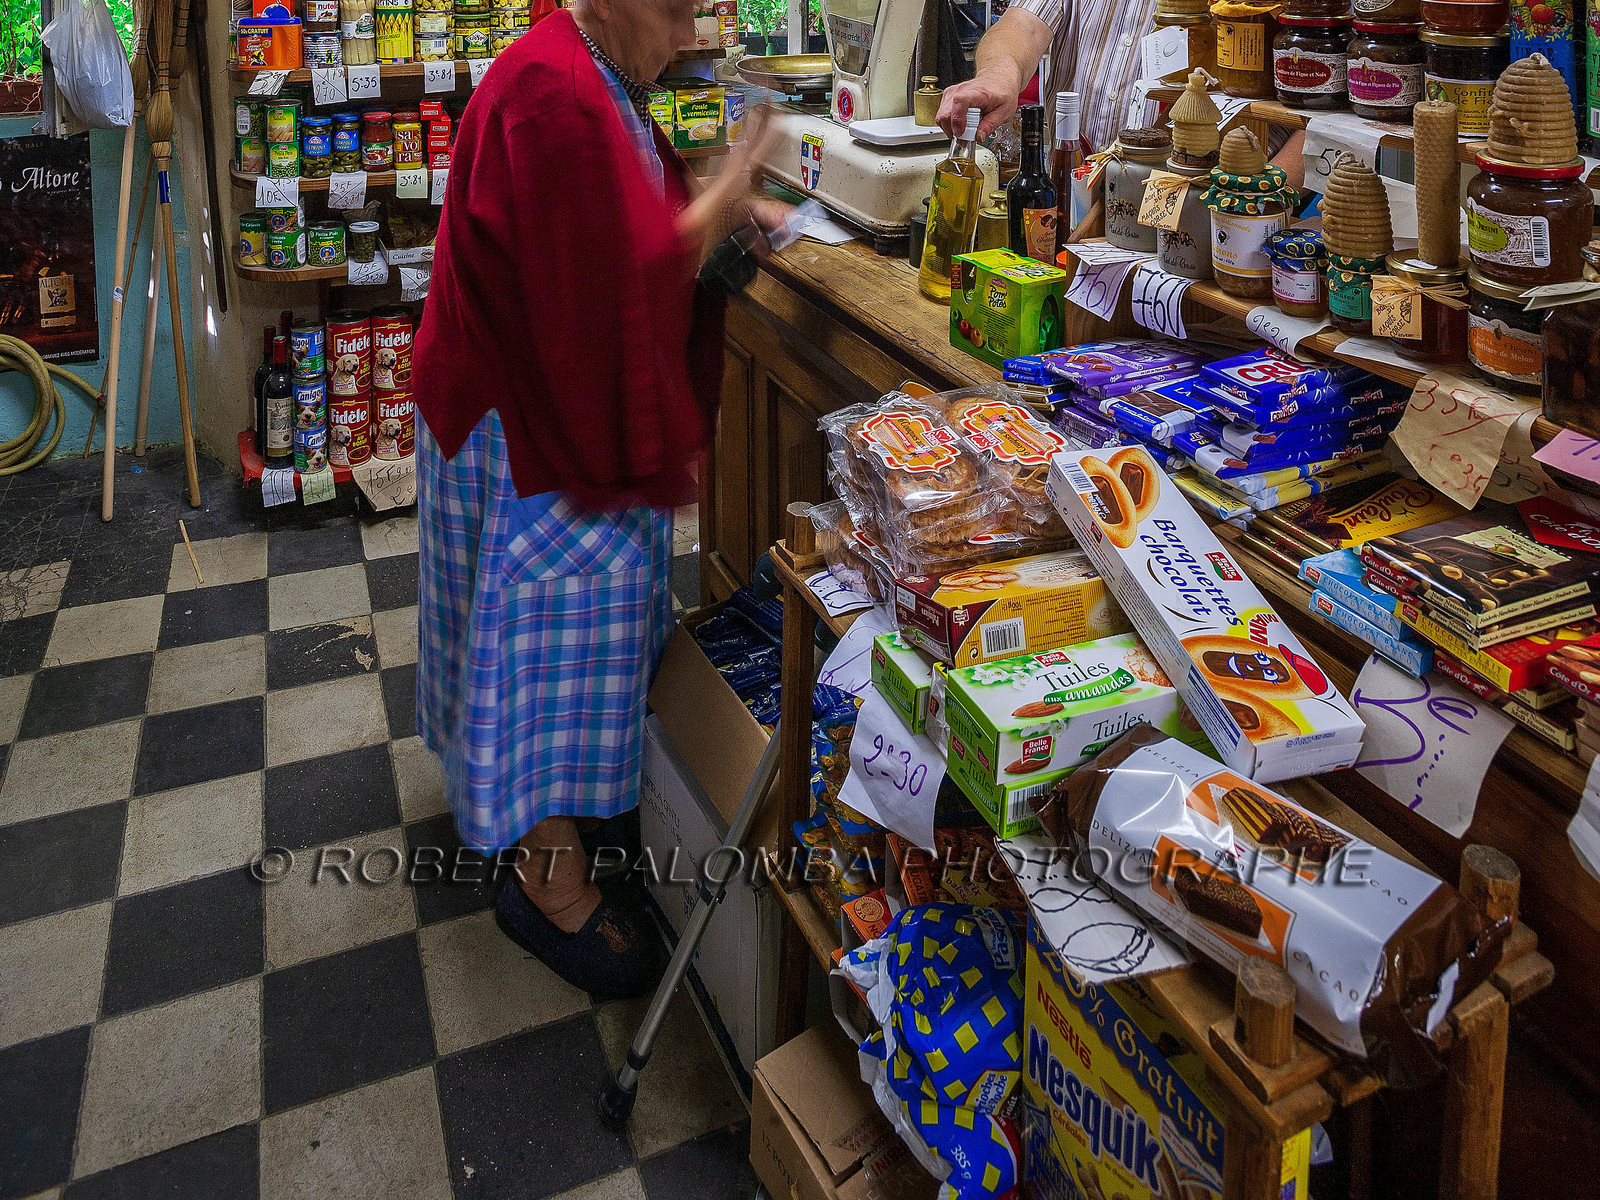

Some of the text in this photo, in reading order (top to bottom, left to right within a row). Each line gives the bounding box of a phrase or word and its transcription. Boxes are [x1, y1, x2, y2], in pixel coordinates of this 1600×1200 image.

[804, 135, 821, 146] CORTE
[11, 167, 80, 193] Altore
[392, 252, 415, 261] Cuisine
[40, 275, 74, 288] ALTORE
[1510, 353, 1534, 364] Melon
[1139, 534, 1212, 617] chocolat
[1152, 518, 1245, 628] Barquettes
[886, 667, 910, 699] Tuiles
[1036, 659, 1110, 694] Tuiles
[1065, 671, 1133, 702] amandes
[1093, 711, 1145, 742] Tuiles
[1024, 745, 1050, 755] France
[1142, 745, 1200, 780] DELIZIA
[967, 760, 996, 796] Tuiles
[1091, 820, 1149, 864] DELIZIA
[1294, 950, 1360, 1003] CACAO
[1036, 979, 1092, 1072] Nestlé
[1113, 1018, 1219, 1157] Gratuit
[1028, 1022, 1162, 1194] Nesquik
